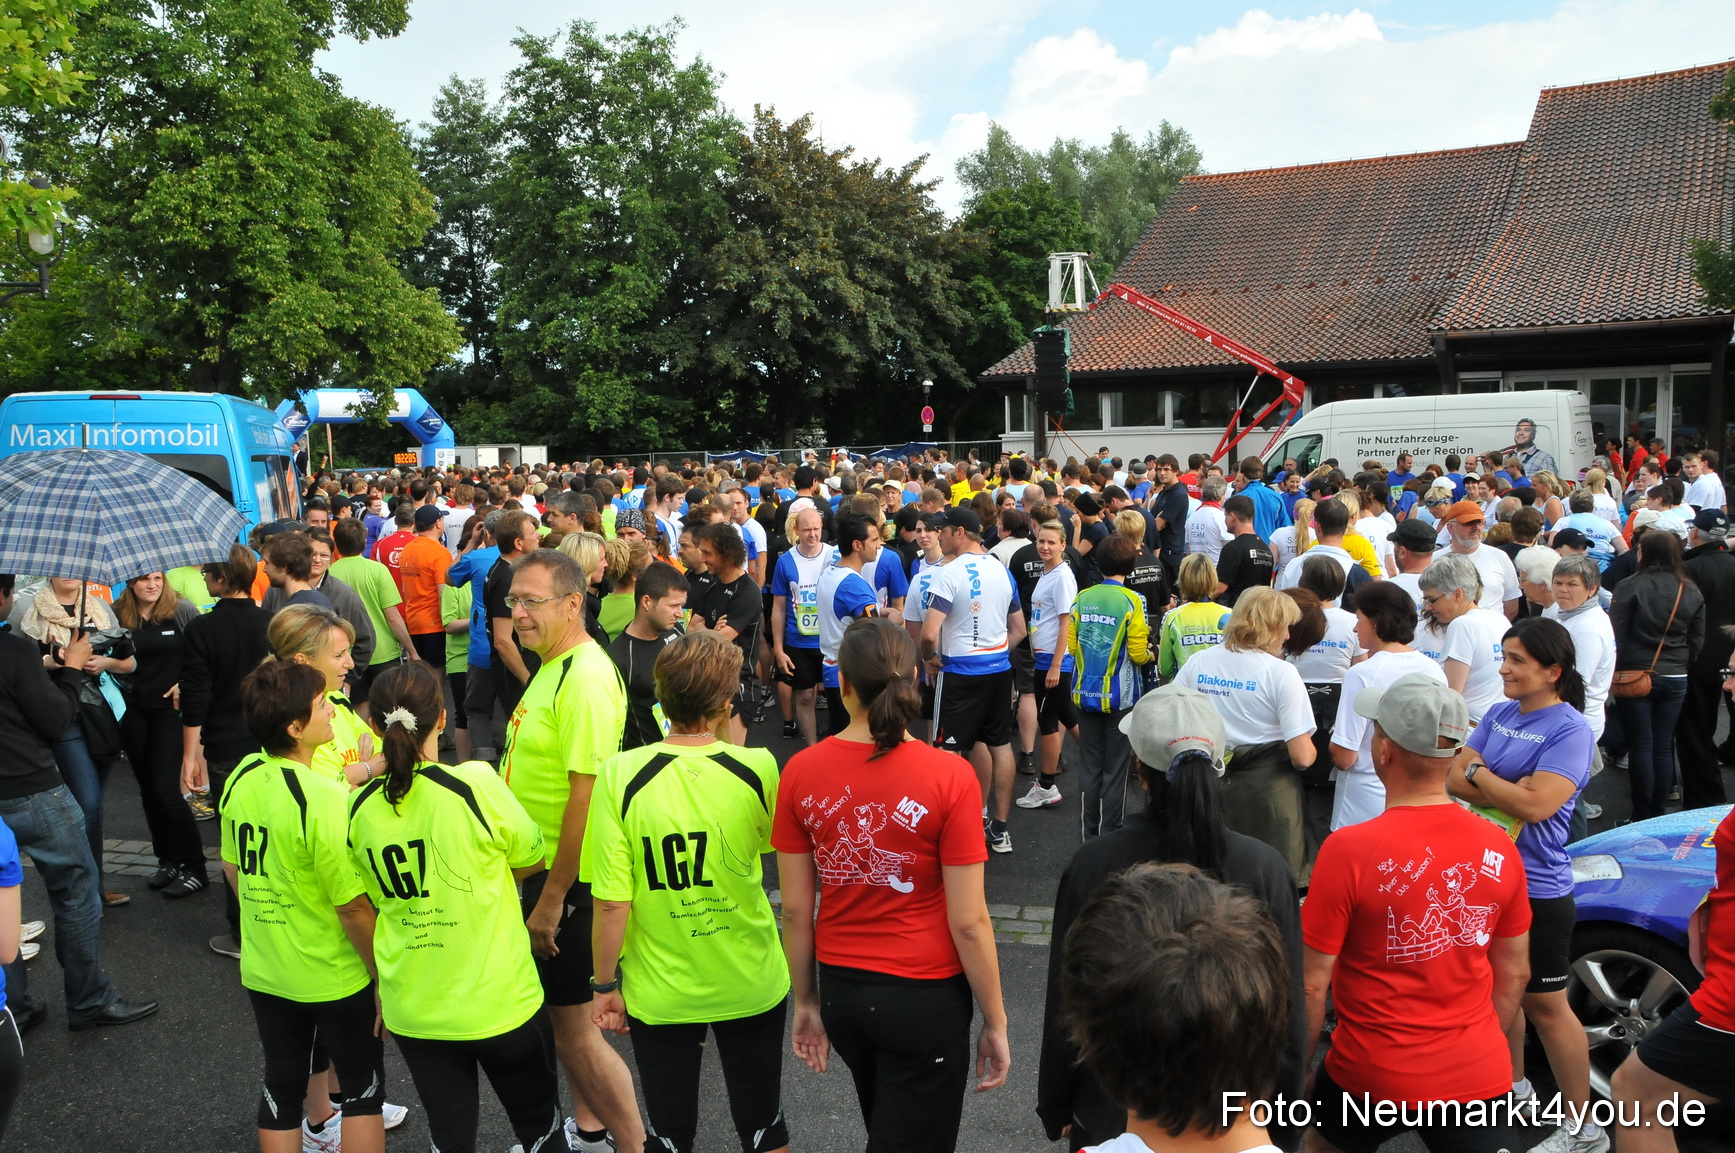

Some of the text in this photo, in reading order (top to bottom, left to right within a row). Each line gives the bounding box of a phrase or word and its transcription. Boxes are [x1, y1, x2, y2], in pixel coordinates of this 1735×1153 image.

[10, 423, 218, 447] Maxi Infomobil
[1357, 434, 1459, 445] Ihr Nutzfahrzeuge-
[1357, 446, 1474, 457] Partner in der Region
[965, 563, 981, 599] TeVi
[1080, 613, 1118, 627] BOCK
[1182, 625, 1214, 634] TEAM
[1197, 674, 1244, 690] Diakonie
[896, 796, 929, 827] MRT
[366, 838, 430, 901] LGZ
[641, 831, 714, 892] LGZ
[1482, 848, 1505, 877] MRT
[415, 932, 428, 940] und
